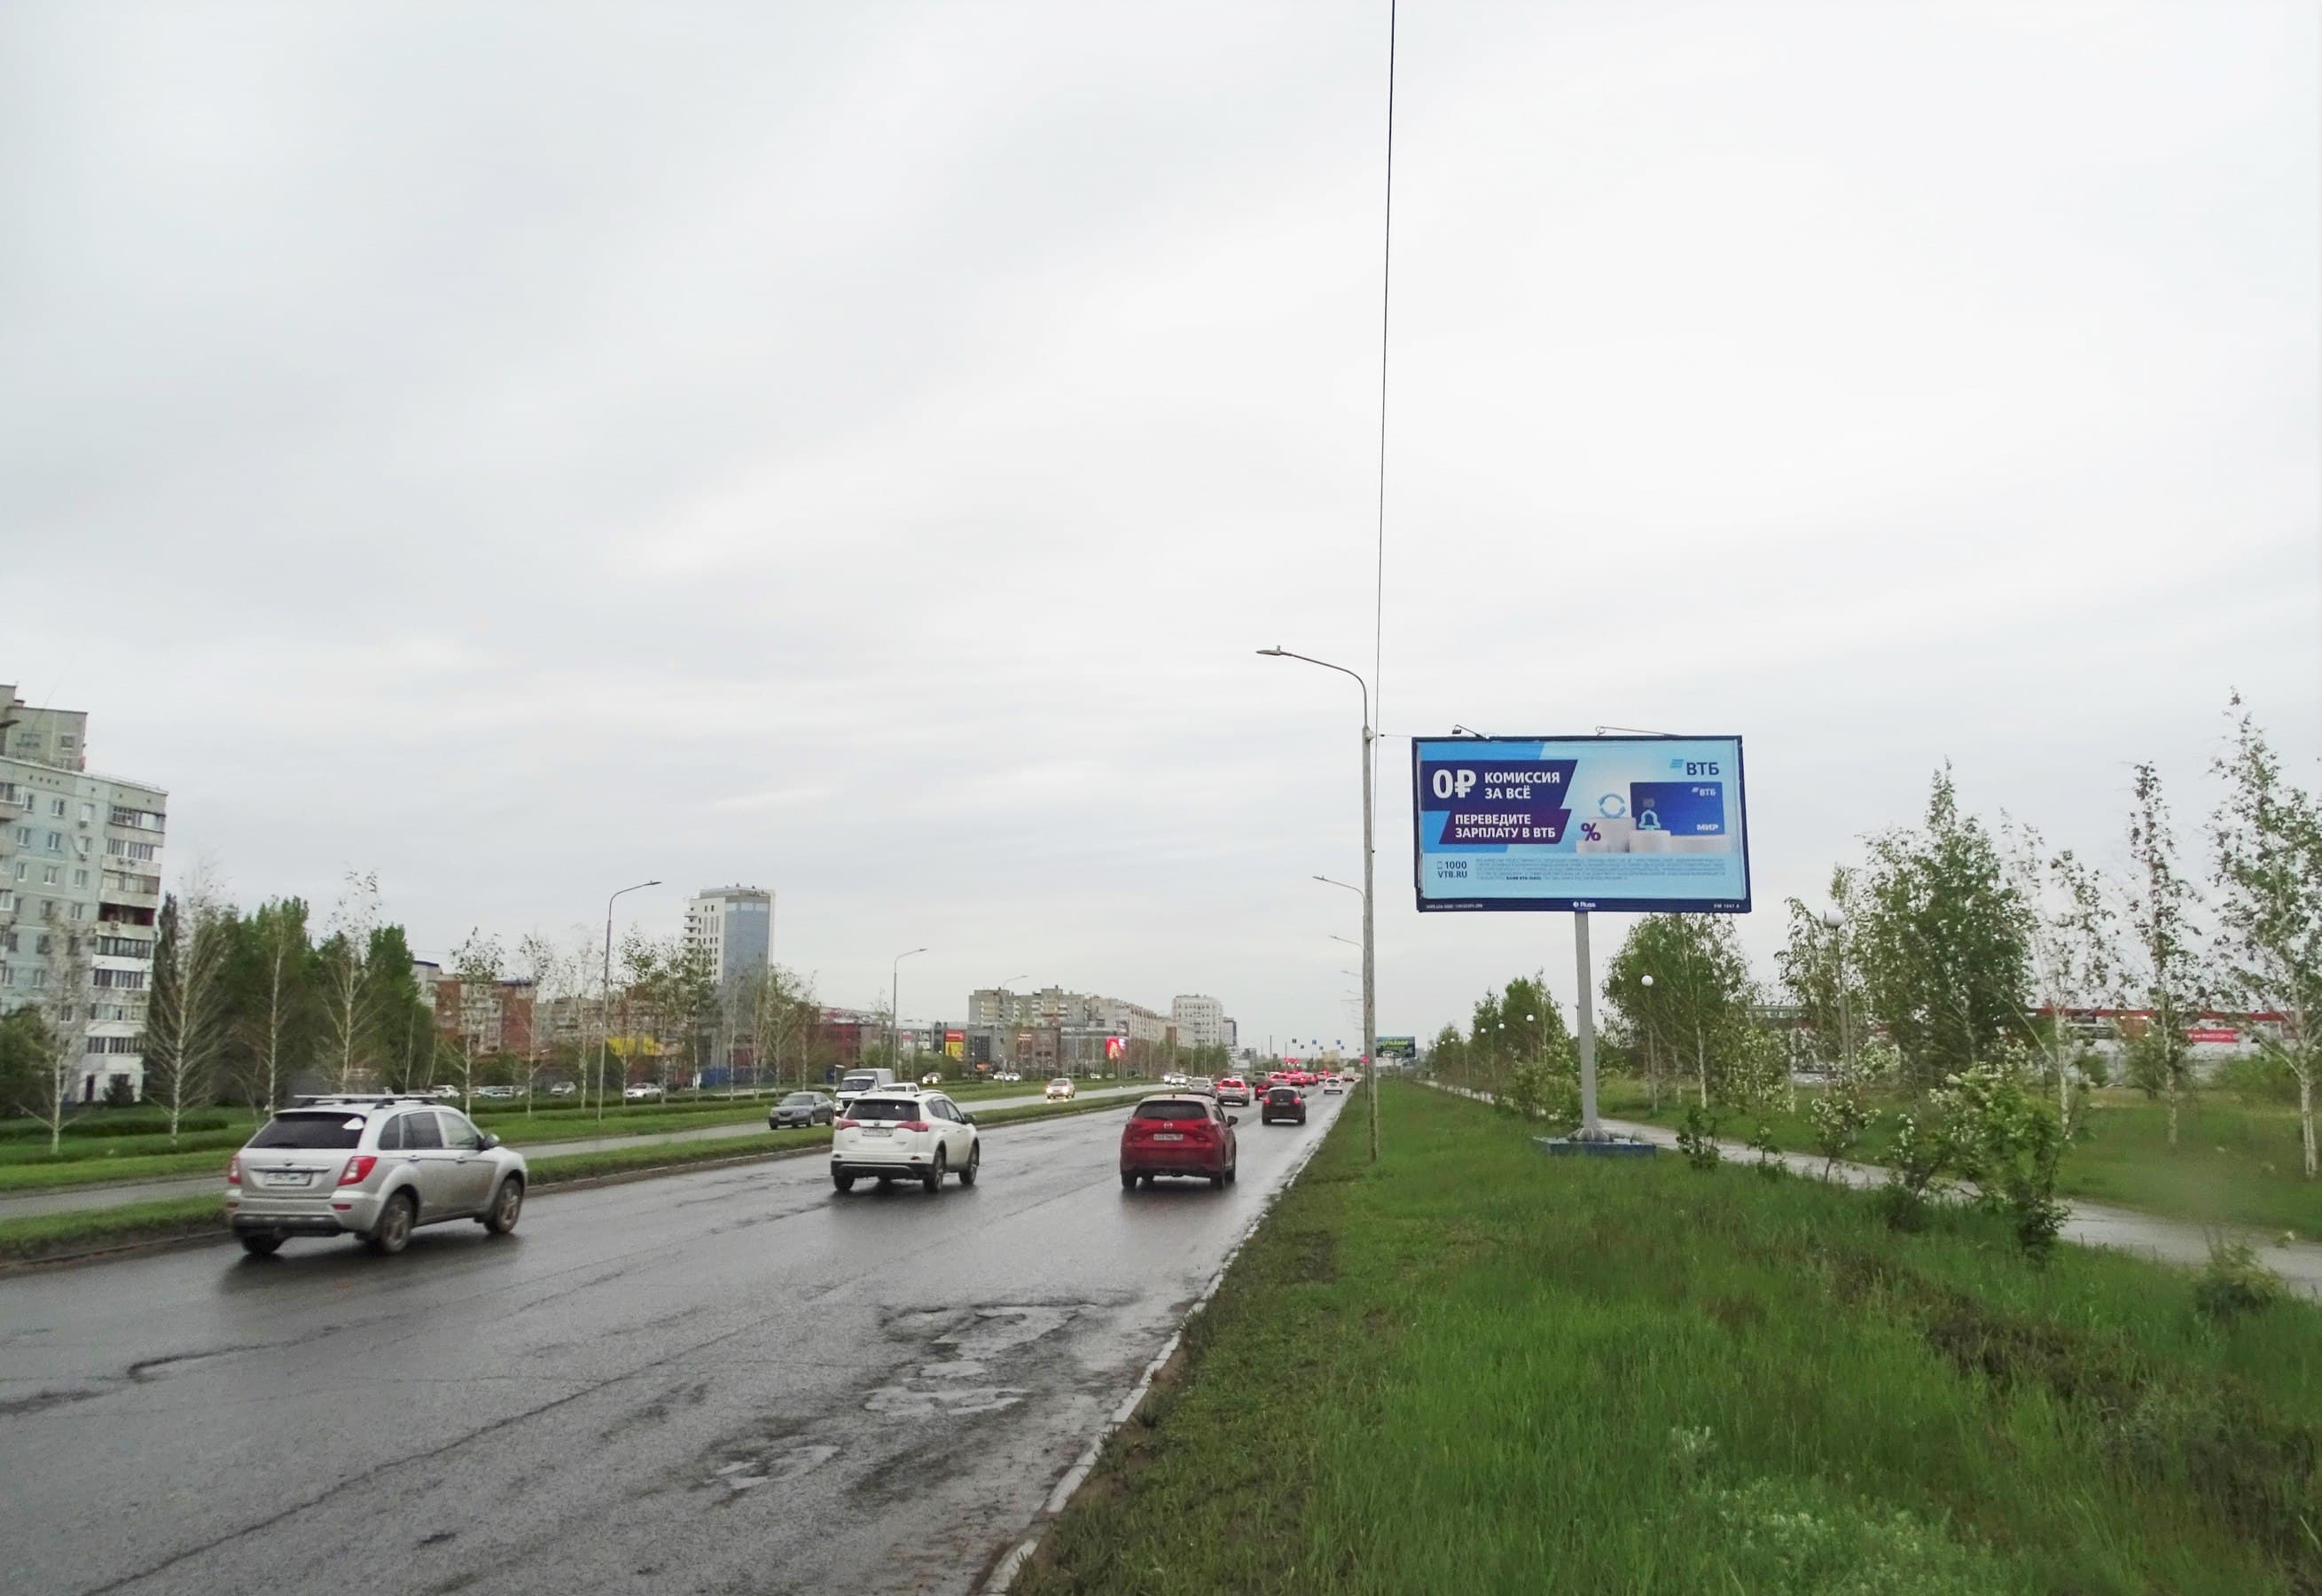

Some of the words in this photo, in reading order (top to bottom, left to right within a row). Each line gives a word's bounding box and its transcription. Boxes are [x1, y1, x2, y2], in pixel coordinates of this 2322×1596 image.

[1686, 762, 1719, 776] ВТБ
[1484, 771, 1560, 784] КОМИССИЯ
[1484, 787, 1503, 799] ЗА
[1506, 786, 1531, 799] ВСЁ
[1699, 787, 1716, 796] ВТБ
[1455, 814, 1531, 826] ПЕРЕВЕДИТЕ
[1455, 827, 1518, 838] ЗАРПЛАТУ
[1522, 827, 1530, 838] В
[1533, 827, 1556, 838] ВТБ
[1445, 861, 1467, 870] 1000
